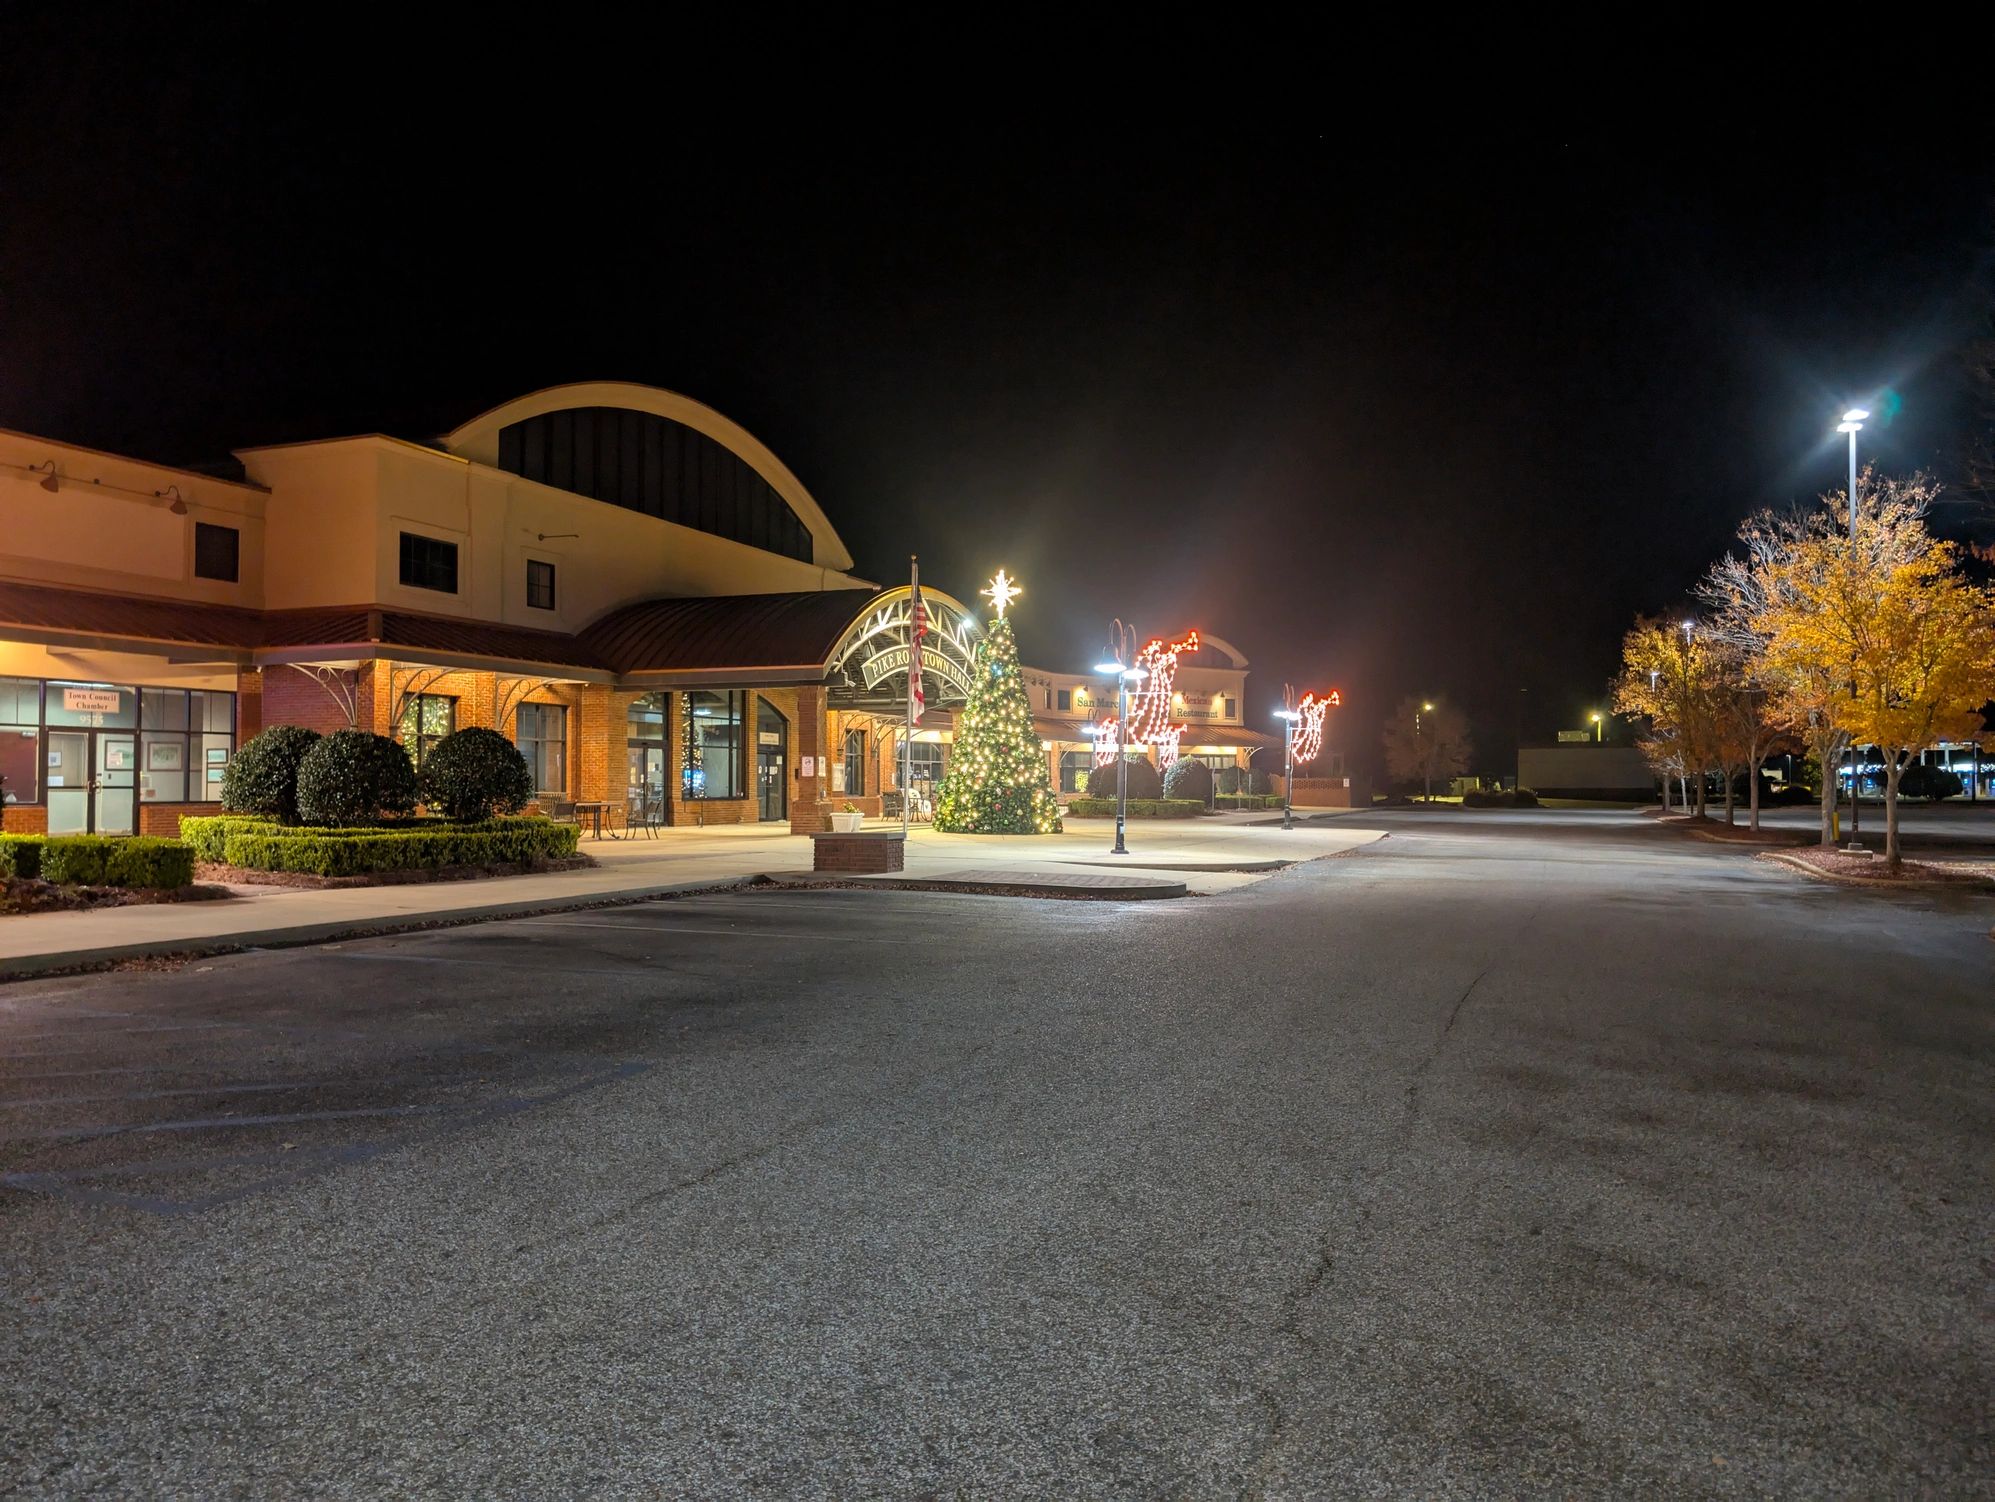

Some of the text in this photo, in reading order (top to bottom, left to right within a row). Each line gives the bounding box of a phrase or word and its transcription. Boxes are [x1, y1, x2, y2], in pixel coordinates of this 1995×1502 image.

[872, 654, 896, 678] PIKE
[922, 651, 950, 674] TOWN
[950, 665, 970, 692] HALL
[89, 693, 117, 702] Council
[1077, 696, 1095, 708] San
[1182, 695, 1213, 706] Mexican
[76, 702, 108, 710] Chamber
[1176, 708, 1218, 719] Restaurant
